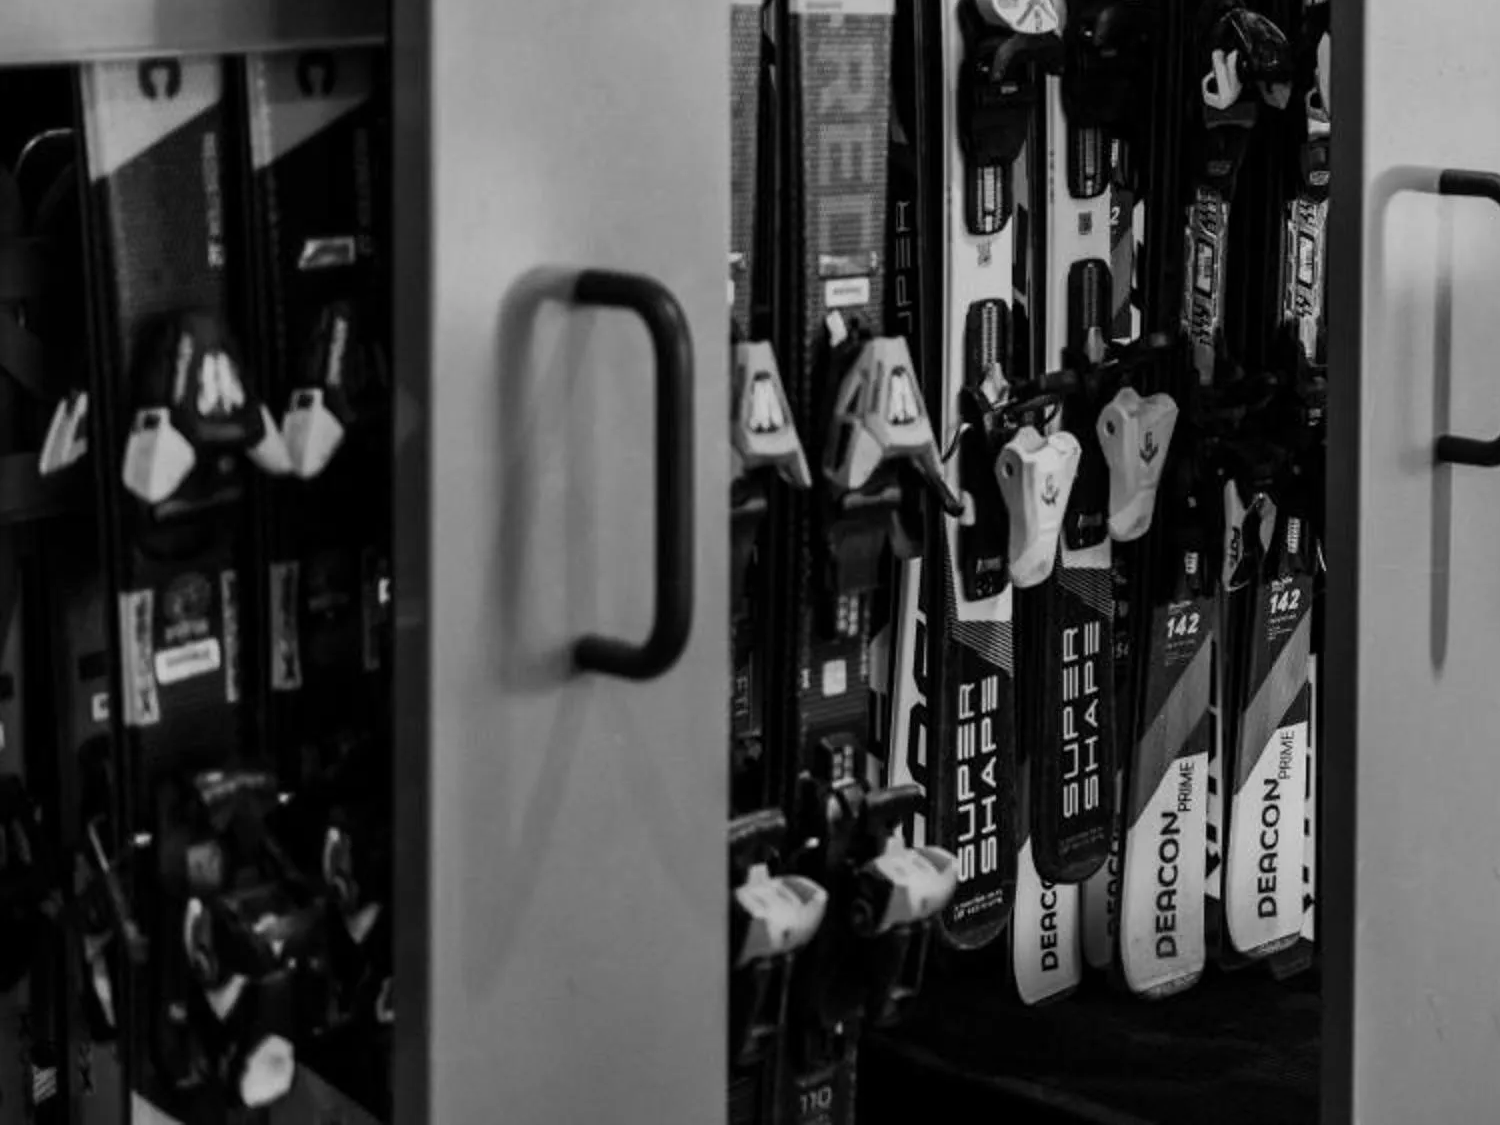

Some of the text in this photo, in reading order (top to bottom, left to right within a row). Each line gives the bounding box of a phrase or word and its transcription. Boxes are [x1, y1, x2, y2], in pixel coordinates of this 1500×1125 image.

[1167, 612, 1200, 639] 142
[1268, 588, 1300, 614] 142
[957, 682, 975, 882] SUPER
[981, 675, 998, 874] SHAPE
[1062, 626, 1079, 818] SUPER
[1083, 621, 1100, 810] SHAPE
[1156, 761, 1195, 960] DEACON PRIME
[1257, 730, 1295, 919] DEACON PRIME
[1040, 879, 1059, 972] DEAC
